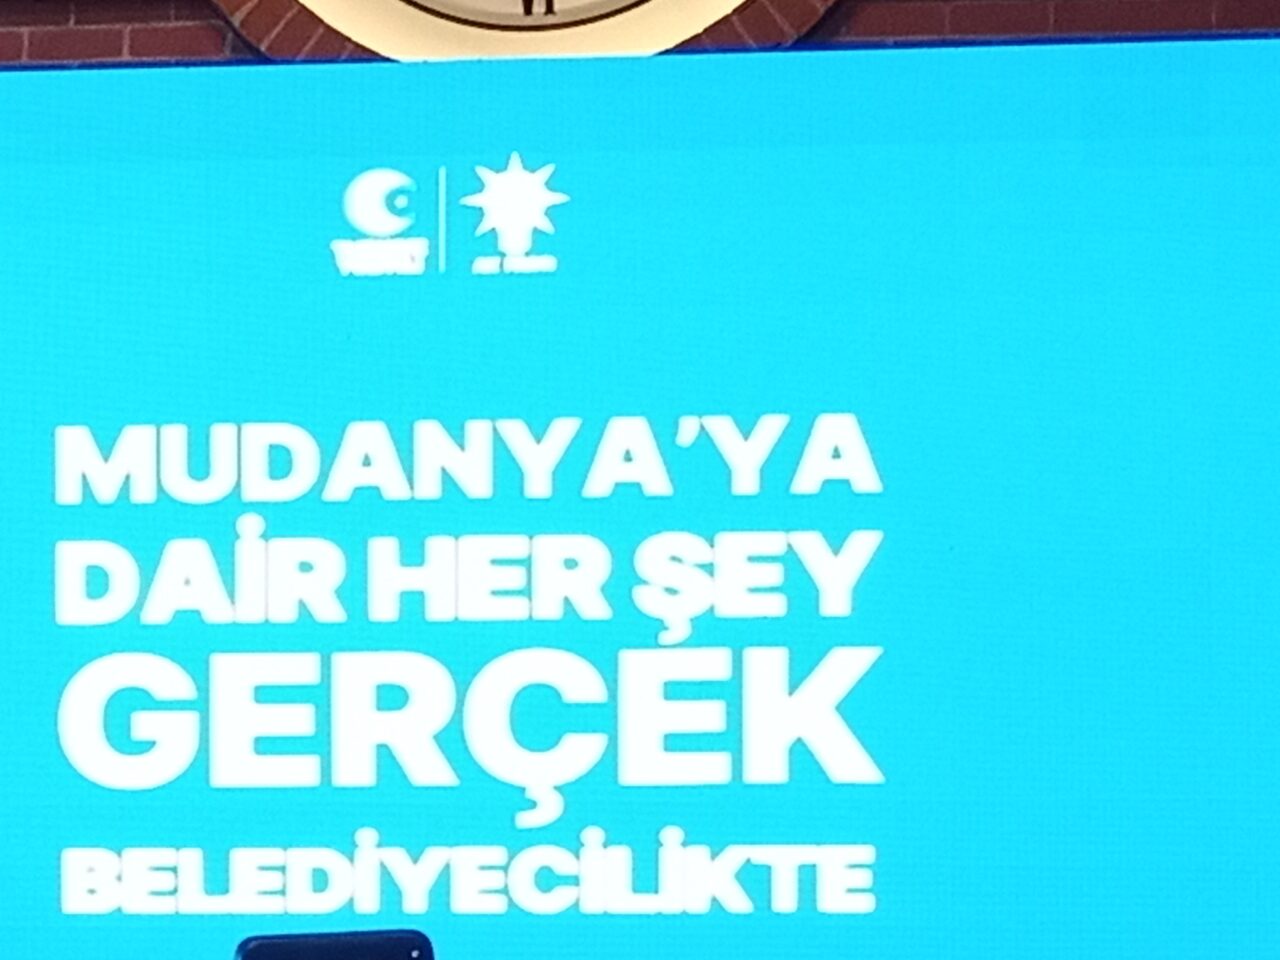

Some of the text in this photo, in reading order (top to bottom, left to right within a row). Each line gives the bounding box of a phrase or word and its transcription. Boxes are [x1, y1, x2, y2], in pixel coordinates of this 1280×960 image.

[54, 413, 883, 505] MUDANYA'YA
[54, 512, 884, 646] DAİR HER ŞEY
[57, 646, 884, 829] GERÇEK
[60, 825, 876, 915] BELEDİYECİLİKTE
